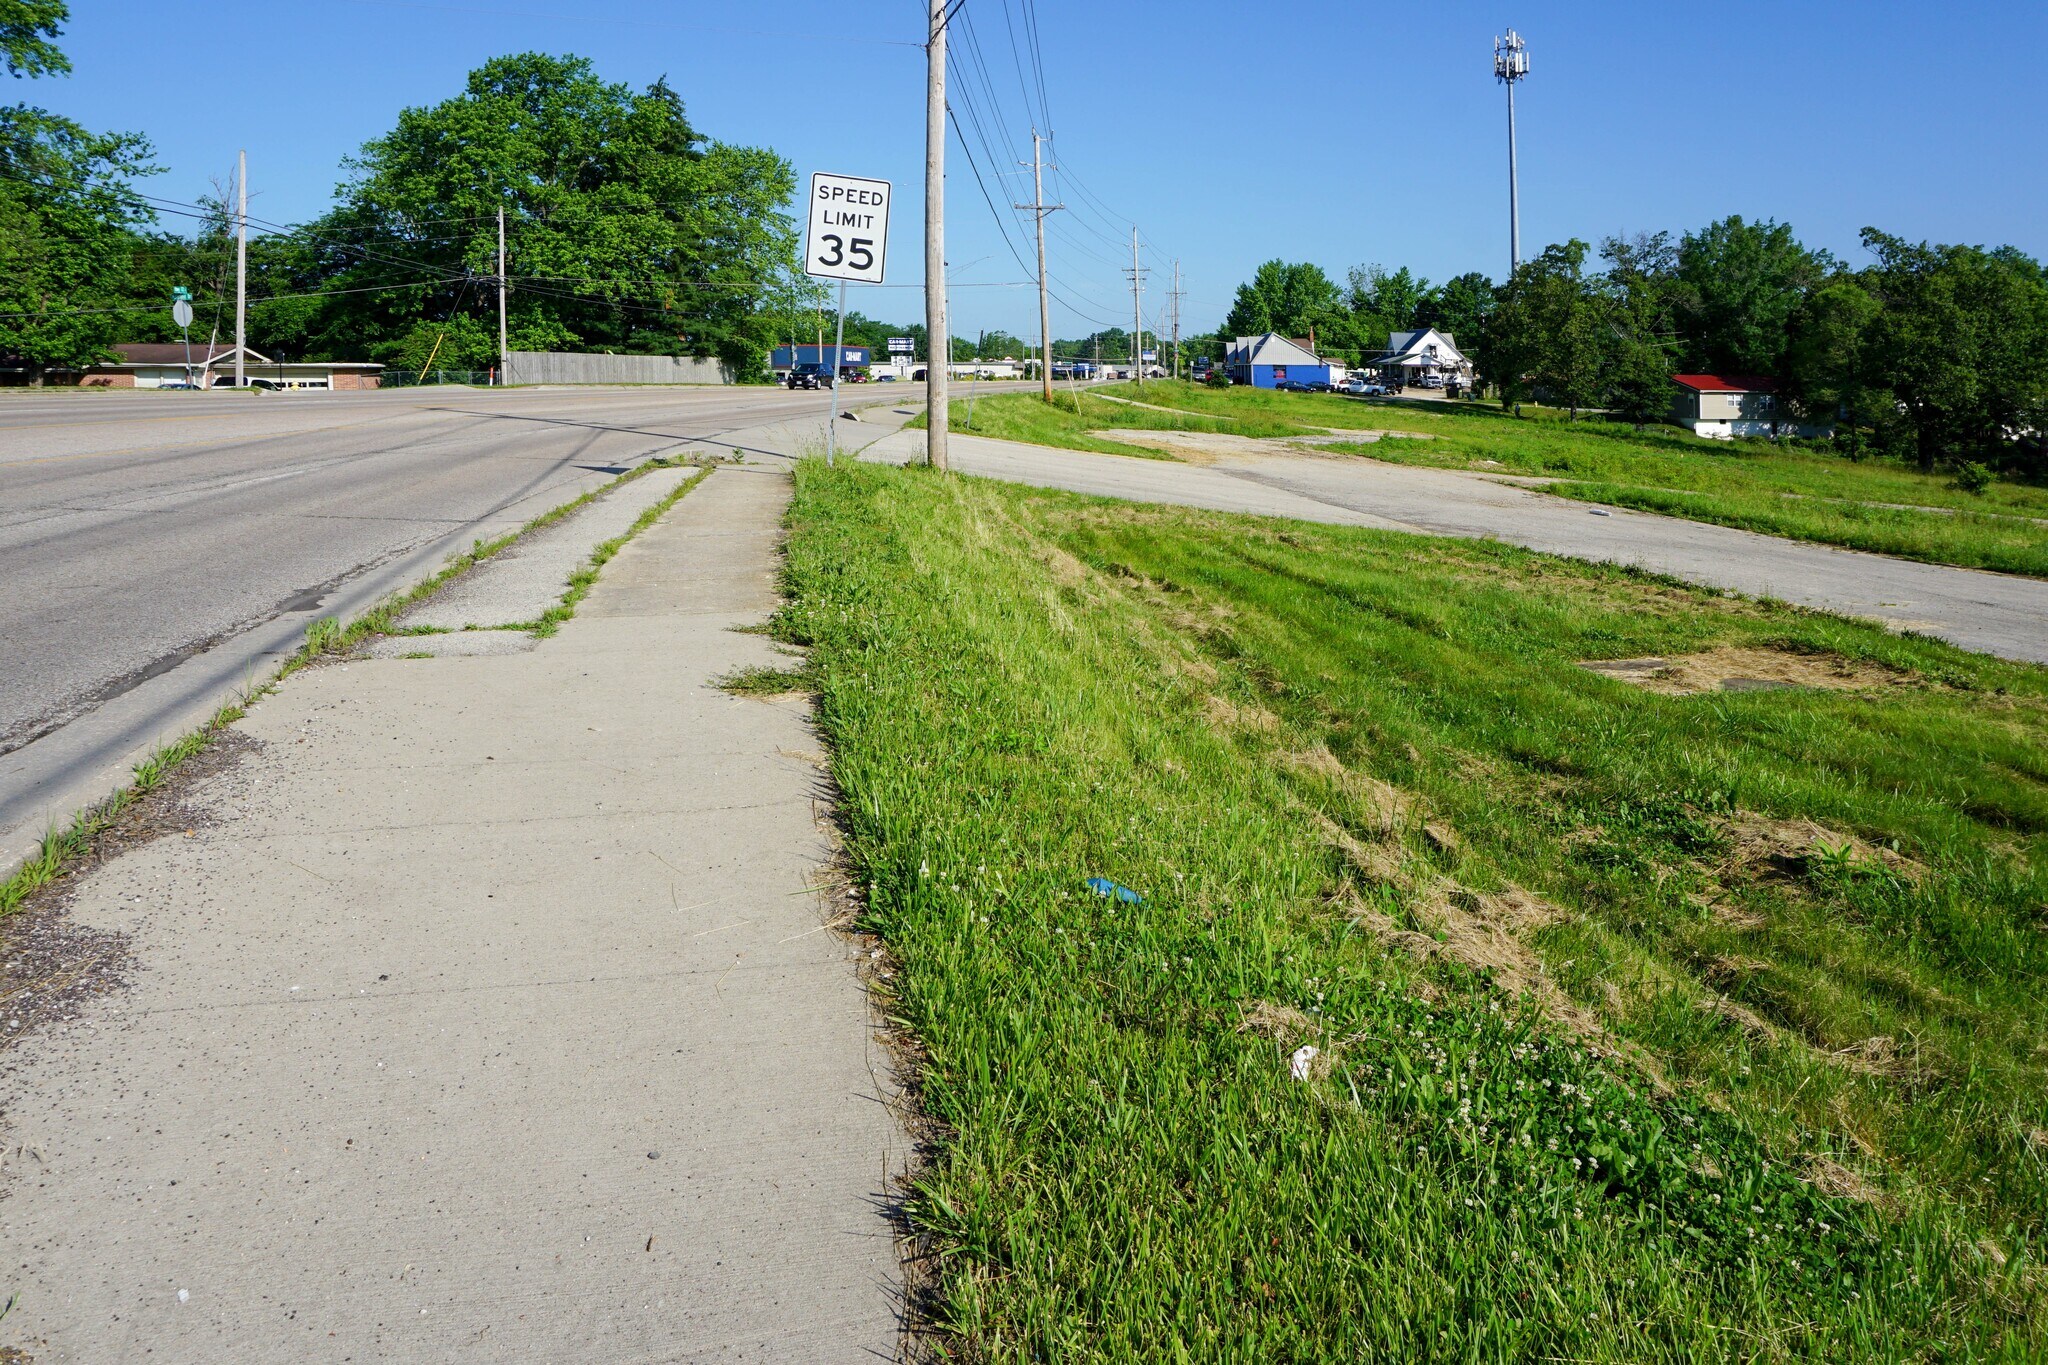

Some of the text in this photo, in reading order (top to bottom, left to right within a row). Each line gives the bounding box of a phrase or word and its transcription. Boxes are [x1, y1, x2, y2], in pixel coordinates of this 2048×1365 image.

[818, 185, 883, 206] SPEED
[823, 210, 874, 229] LIMIT
[818, 234, 874, 270] 35
